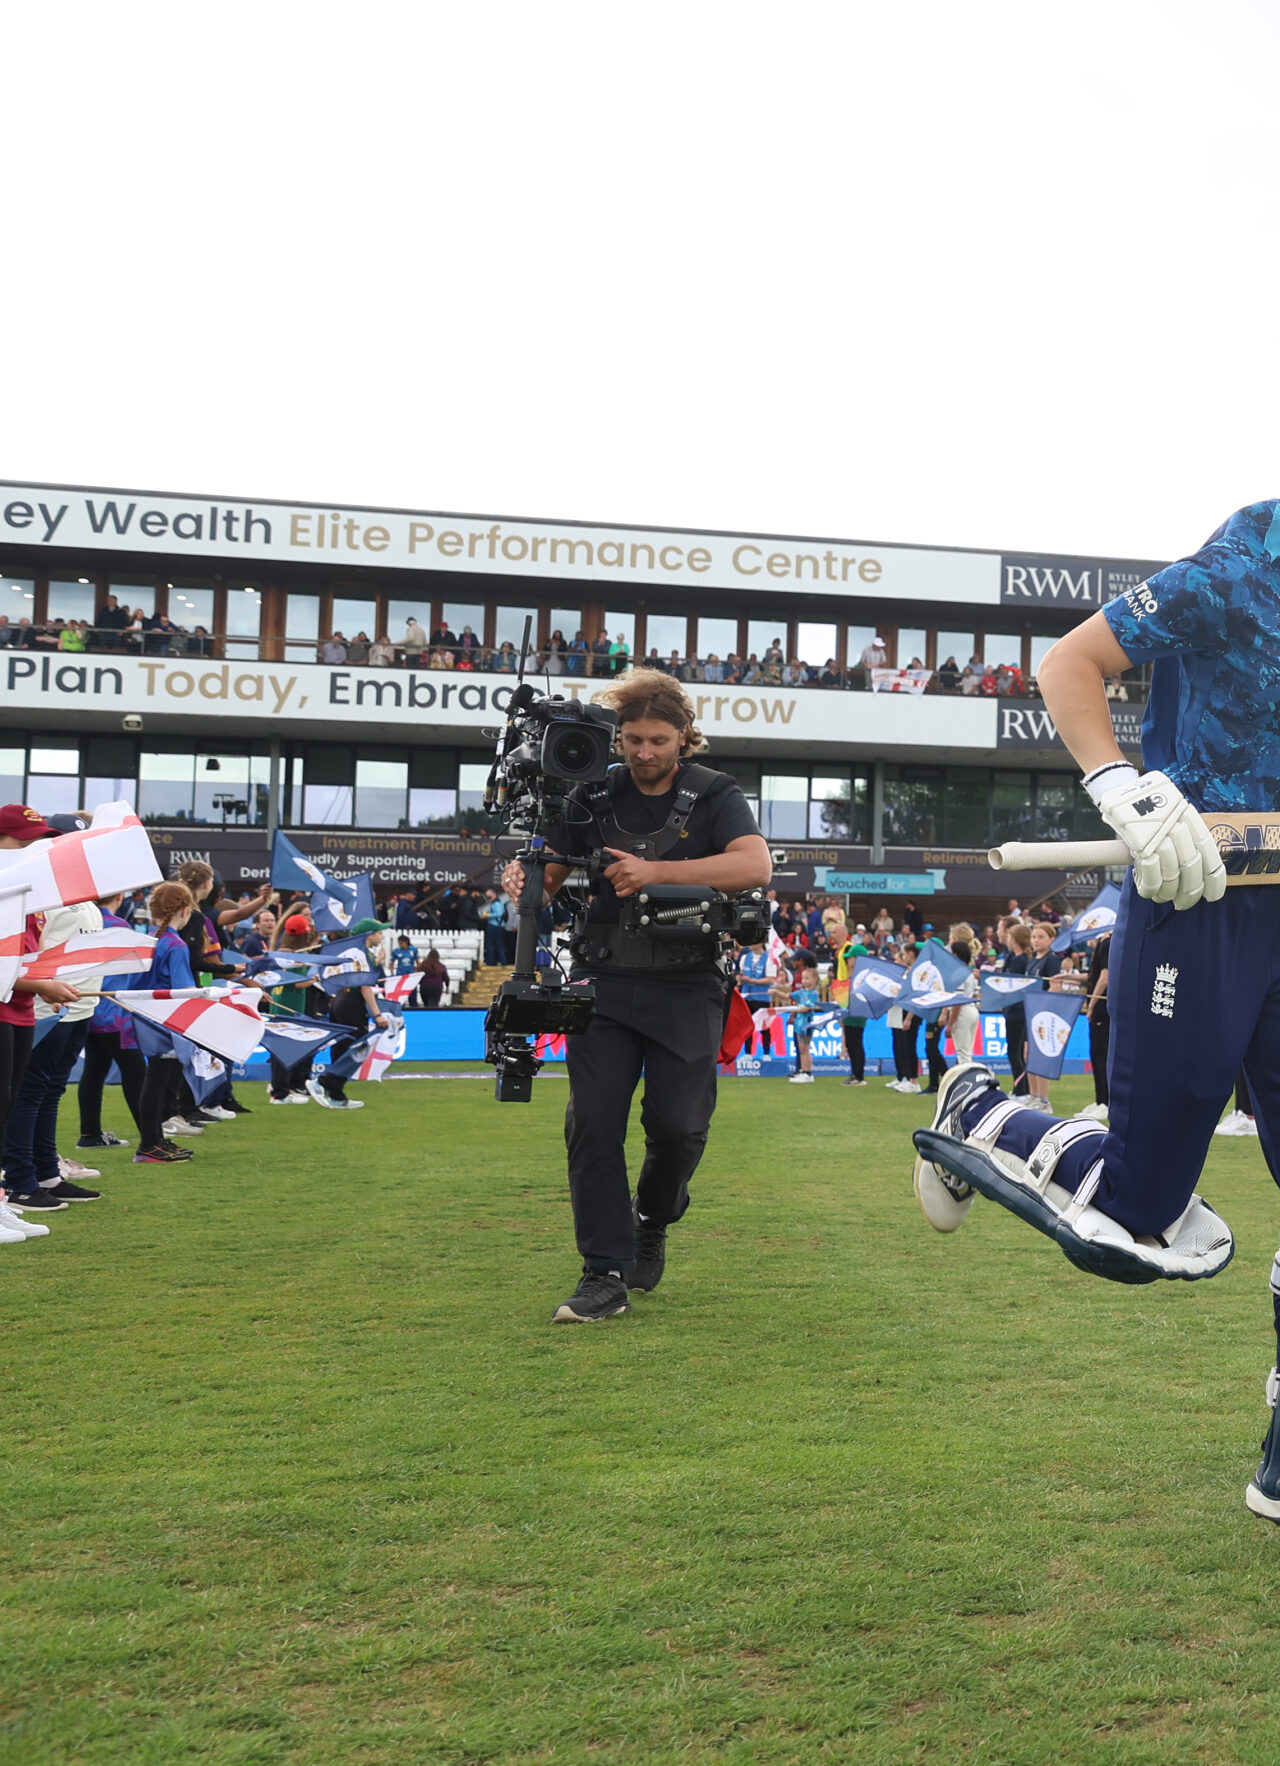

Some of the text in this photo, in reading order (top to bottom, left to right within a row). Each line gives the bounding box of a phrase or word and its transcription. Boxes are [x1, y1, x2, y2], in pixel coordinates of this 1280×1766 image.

[85, 499, 272, 545] Wealth
[289, 512, 391, 552] Elite
[408, 522, 713, 574] Performance
[732, 544, 883, 584] Centre
[1004, 565, 1093, 601] RWM
[1108, 572, 1142, 584] RYLEY
[1133, 580, 1159, 614] TRO
[7, 655, 123, 695] Plan
[138, 661, 310, 714] Today,
[1001, 708, 1059, 741] RW
[1110, 714, 1138, 724] YLEY
[321, 836, 492, 856] Investment Planning
[346, 855, 427, 870] Supporting
[379, 870, 433, 883] Cricket
